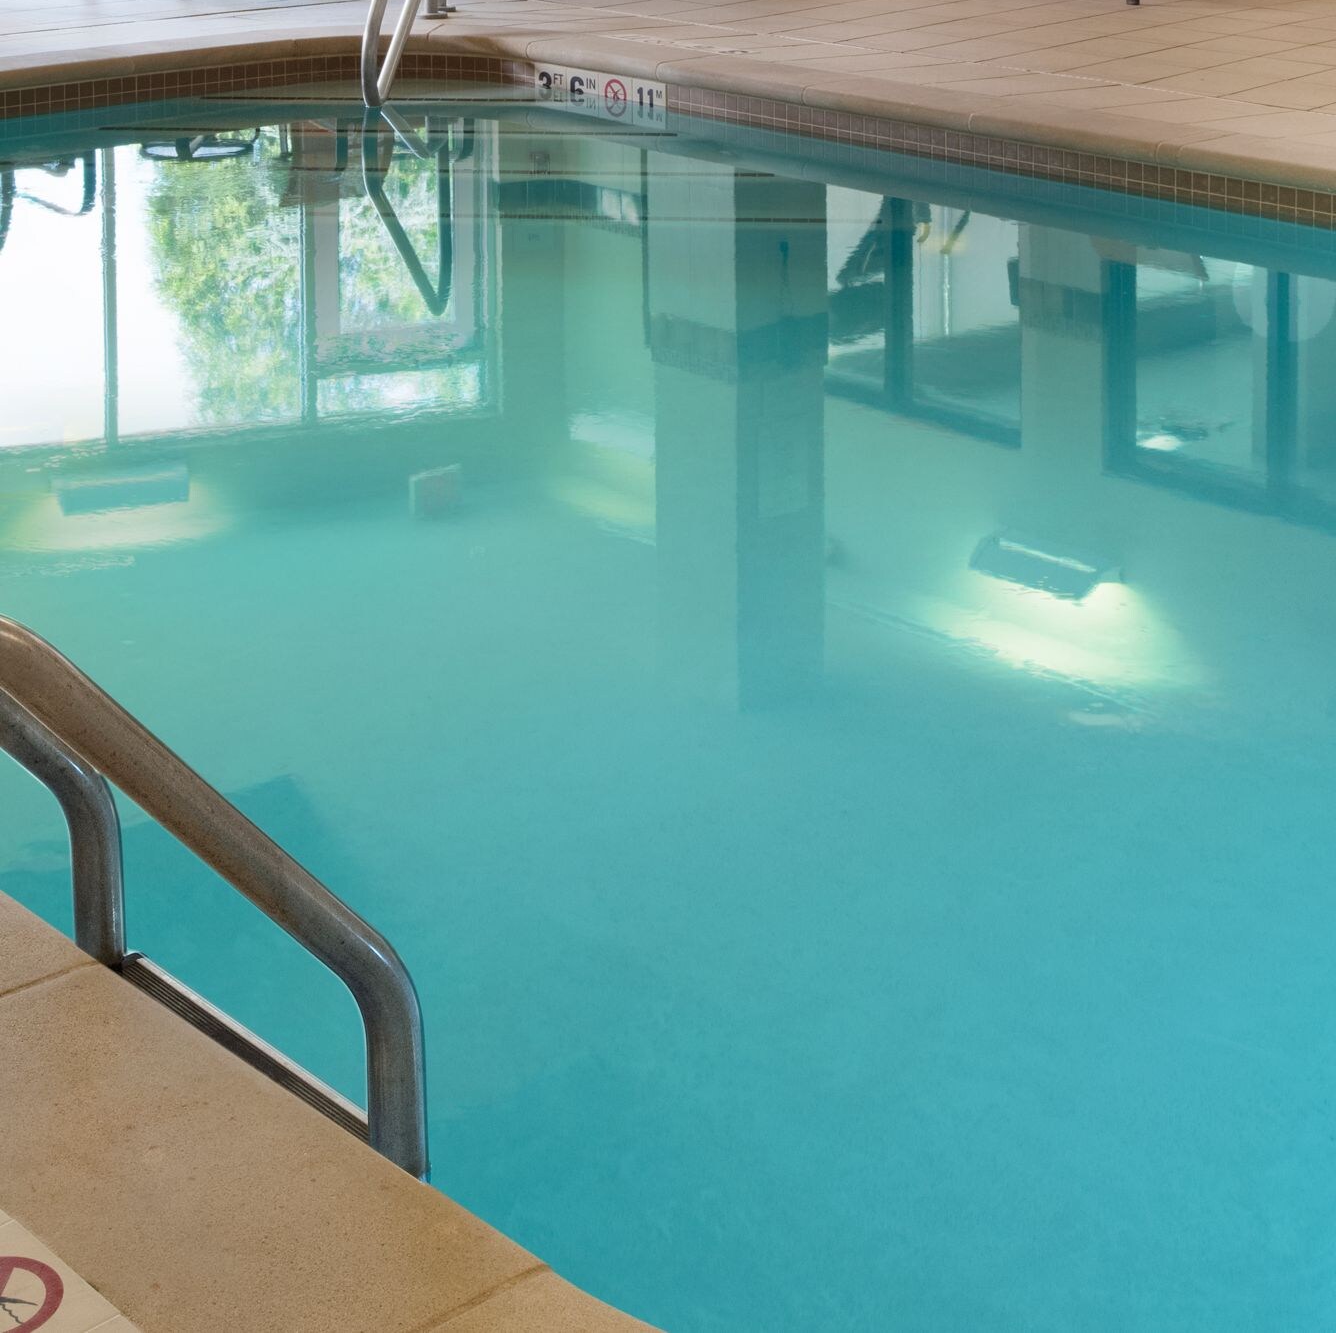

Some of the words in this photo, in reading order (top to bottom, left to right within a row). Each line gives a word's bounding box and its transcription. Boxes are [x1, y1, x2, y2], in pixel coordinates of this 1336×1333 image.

[538, 71, 552, 90] 3
[553, 73, 564, 85] FT
[570, 76, 584, 95] 6
[586, 77, 596, 90] IN
